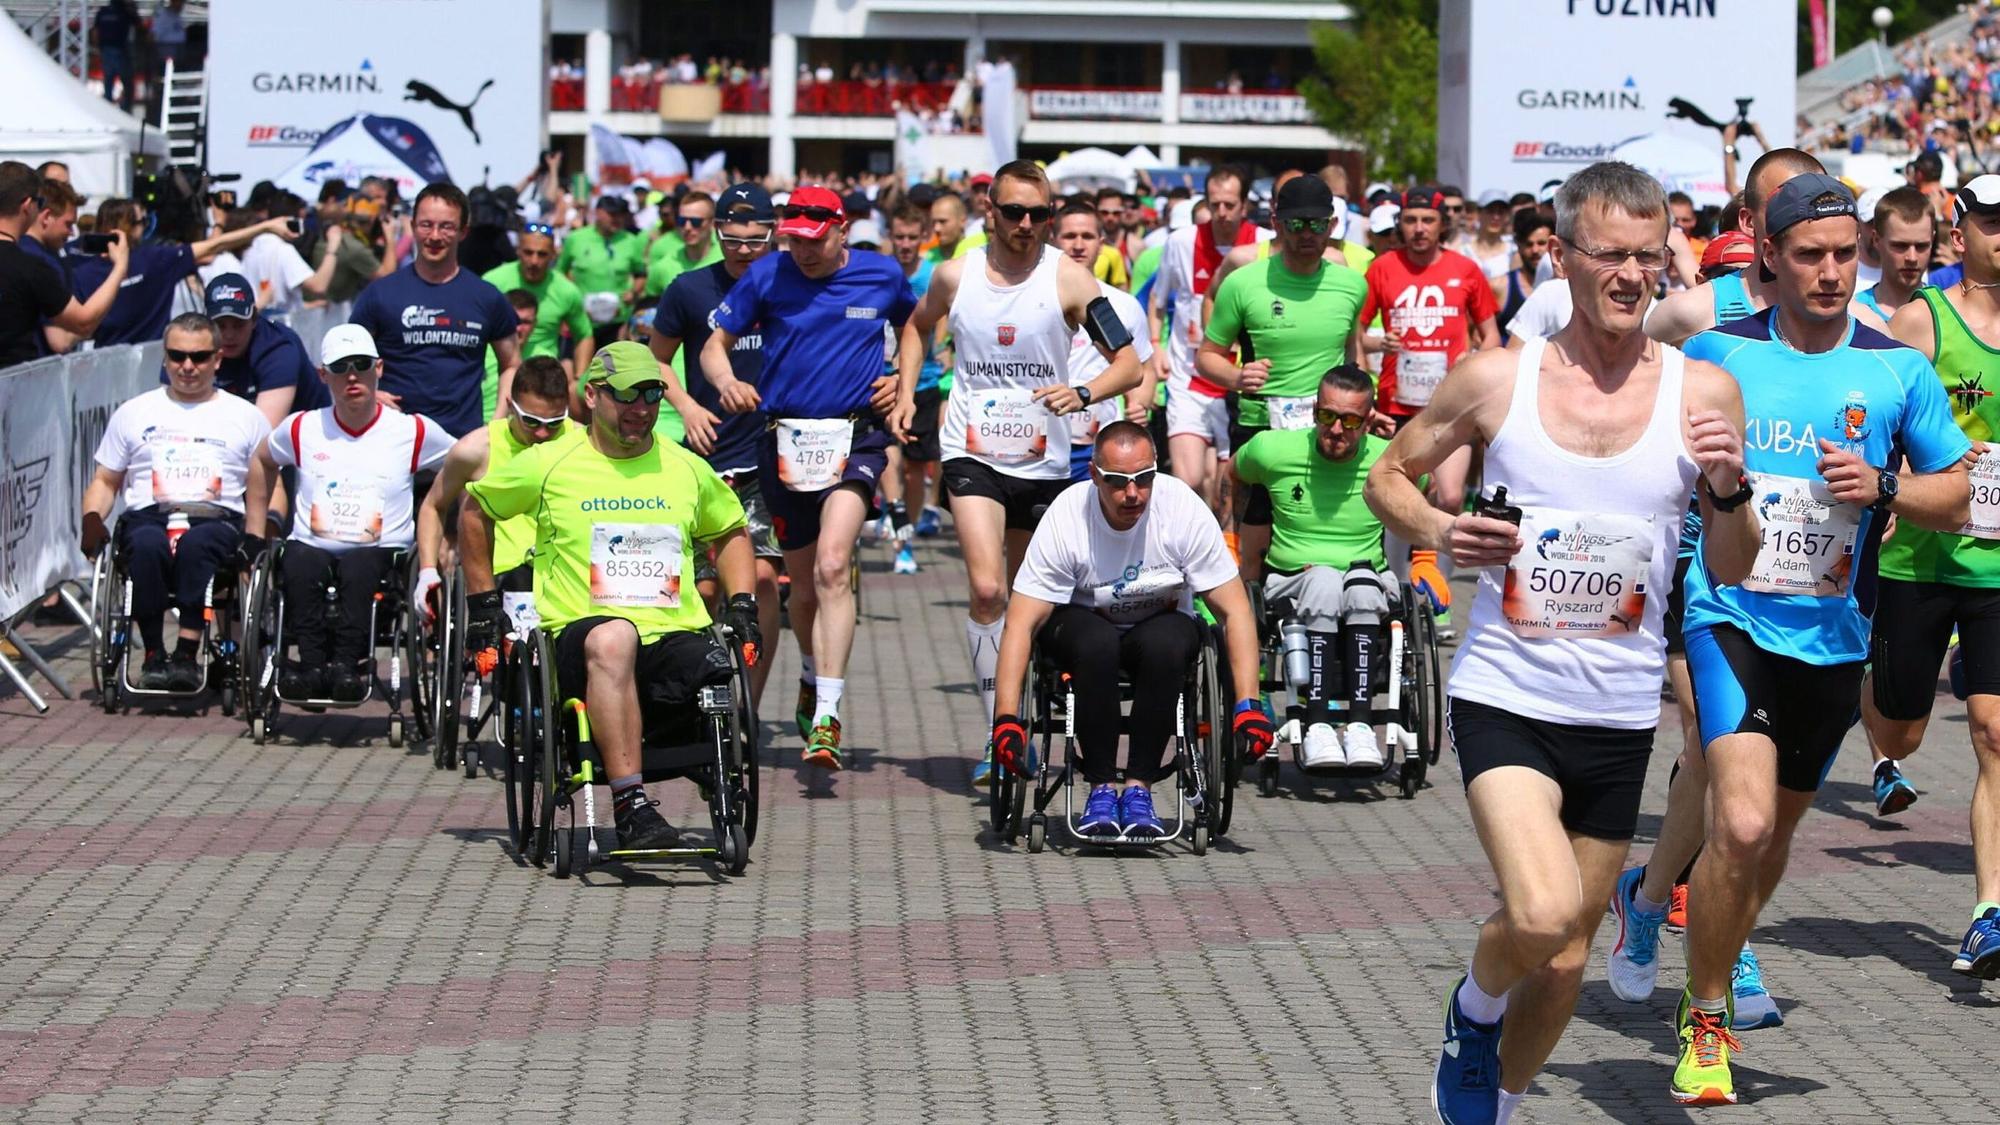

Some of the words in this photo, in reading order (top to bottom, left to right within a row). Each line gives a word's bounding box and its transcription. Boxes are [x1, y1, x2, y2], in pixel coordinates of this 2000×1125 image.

[980, 422, 1034, 438] 64820
[795, 449, 835, 466] 4787
[332, 502, 361, 518] 322
[605, 560, 664, 578] 85352
[1772, 557, 1810, 571] Adam
[1529, 567, 1624, 597] 50706
[1544, 599, 1604, 615] Ryszard
[1309, 635, 1327, 701] kalenji
[1355, 633, 1372, 702] kalenji
